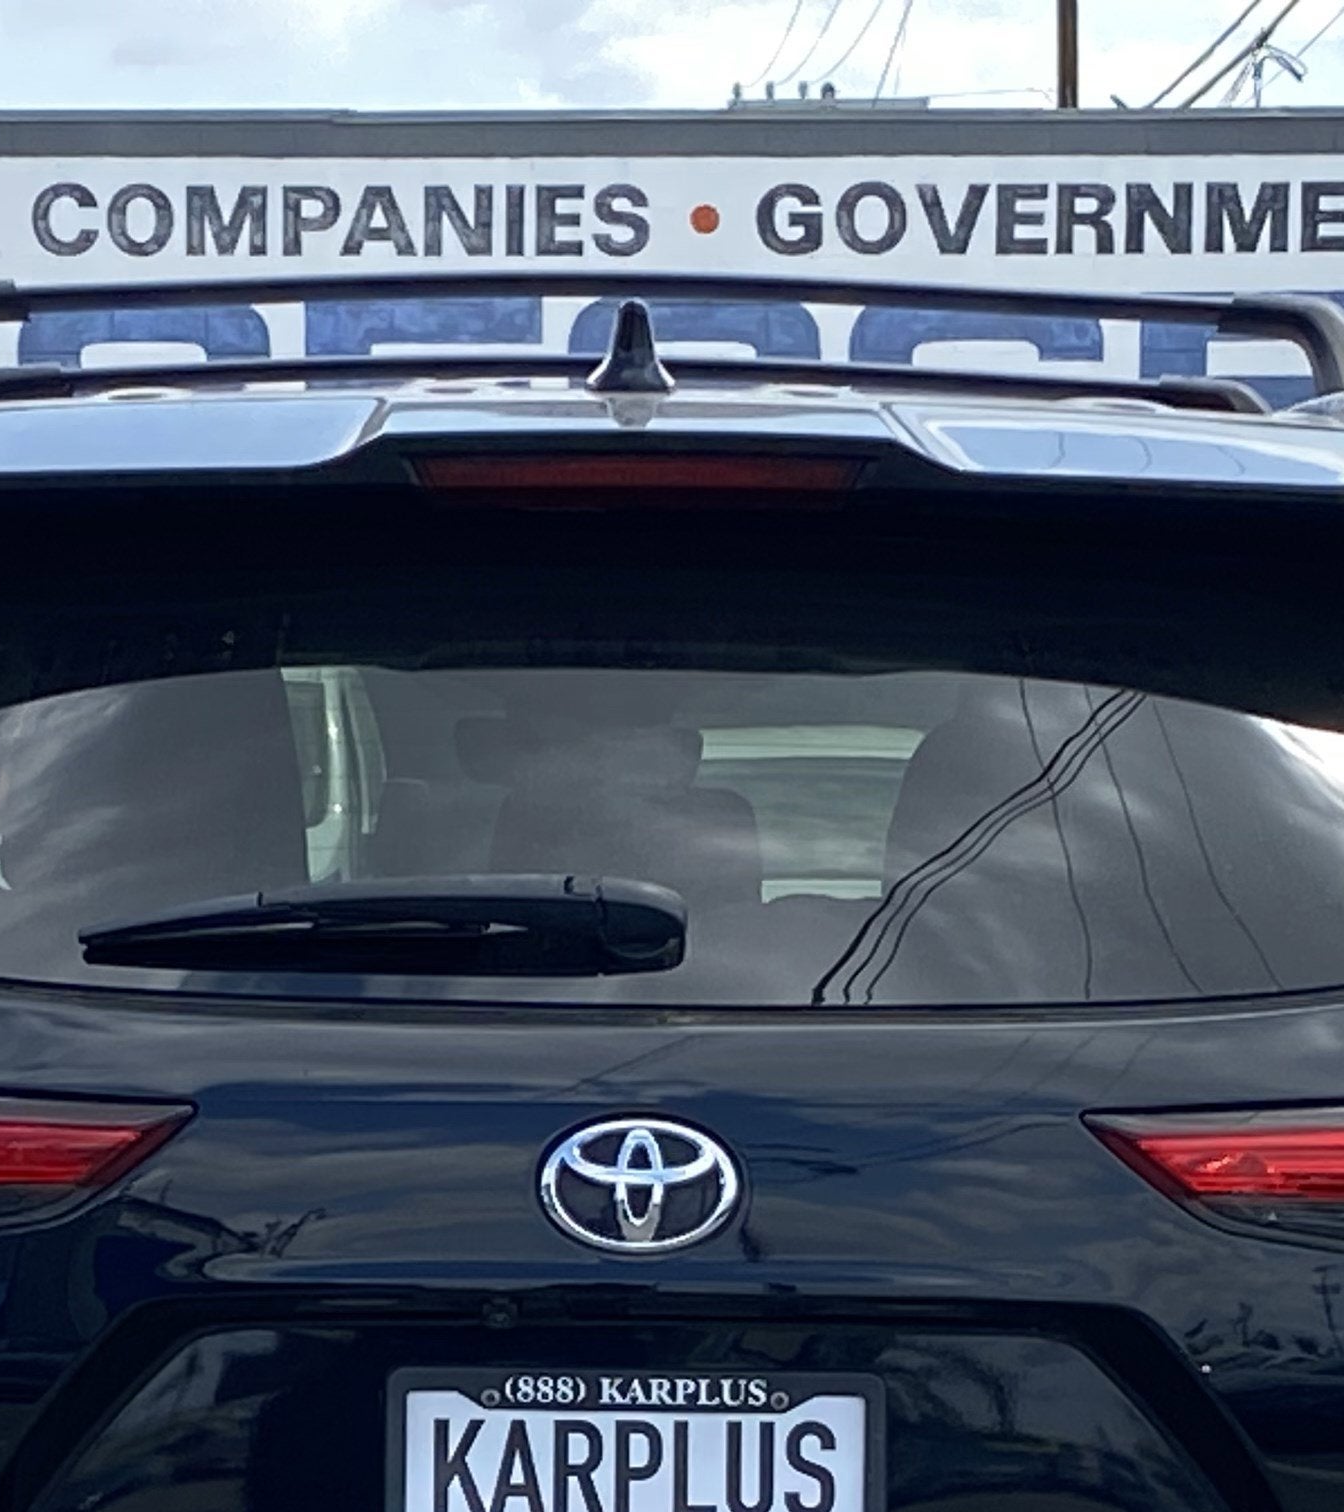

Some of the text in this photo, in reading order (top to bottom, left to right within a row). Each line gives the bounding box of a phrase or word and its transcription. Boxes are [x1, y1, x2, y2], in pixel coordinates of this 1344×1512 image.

[32, 183, 650, 258] COMPANIES
[504, 1375, 767, 1407] (888) KARPLUS
